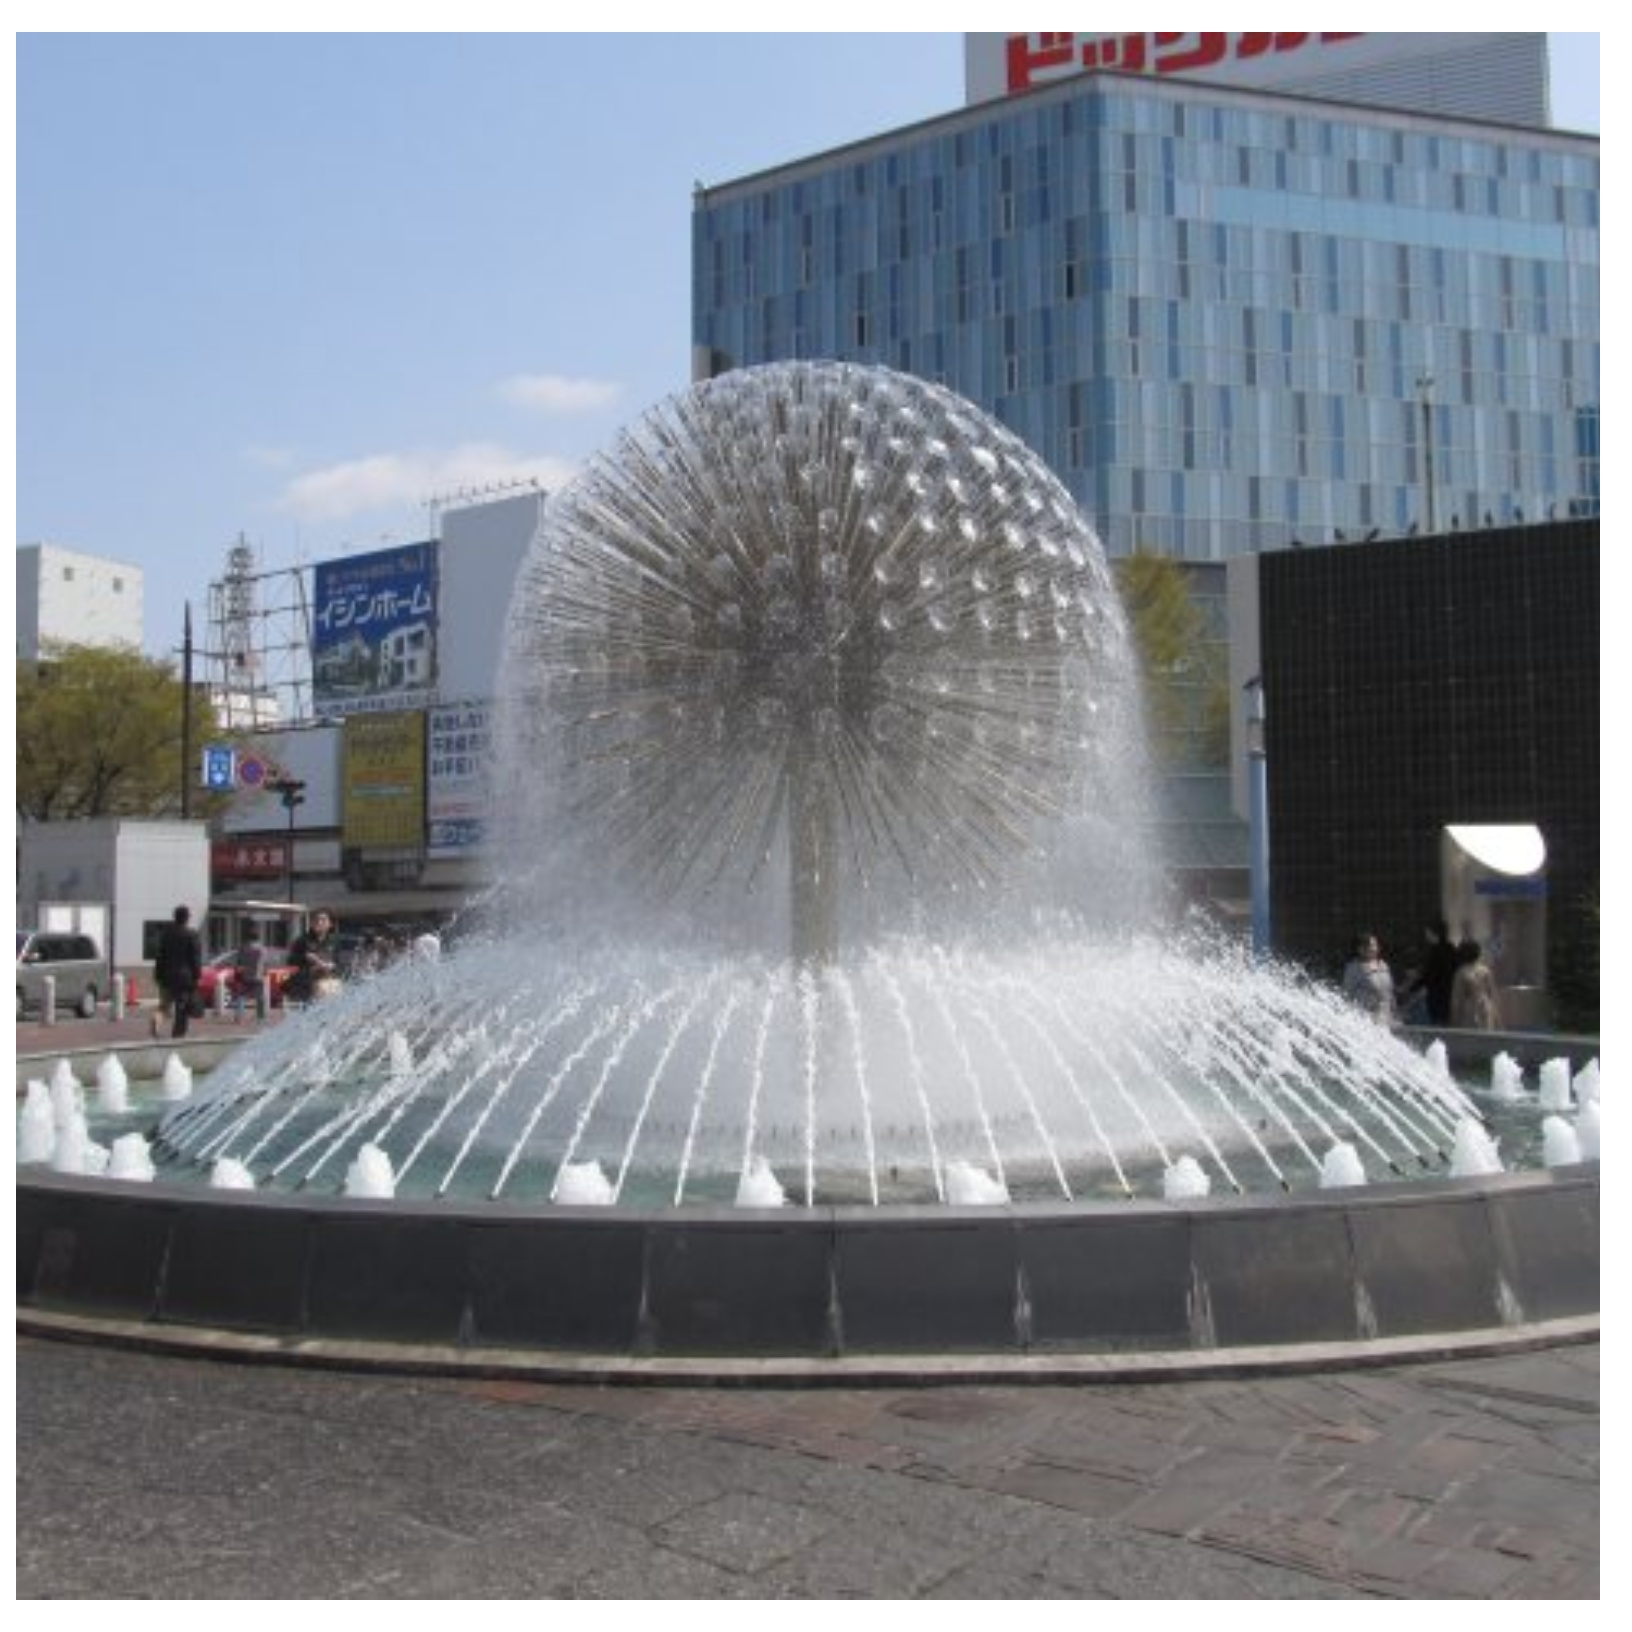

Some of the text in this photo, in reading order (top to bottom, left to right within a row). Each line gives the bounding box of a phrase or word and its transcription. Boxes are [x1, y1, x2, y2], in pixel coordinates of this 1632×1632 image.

[316, 582, 433, 631] イシンホーム
